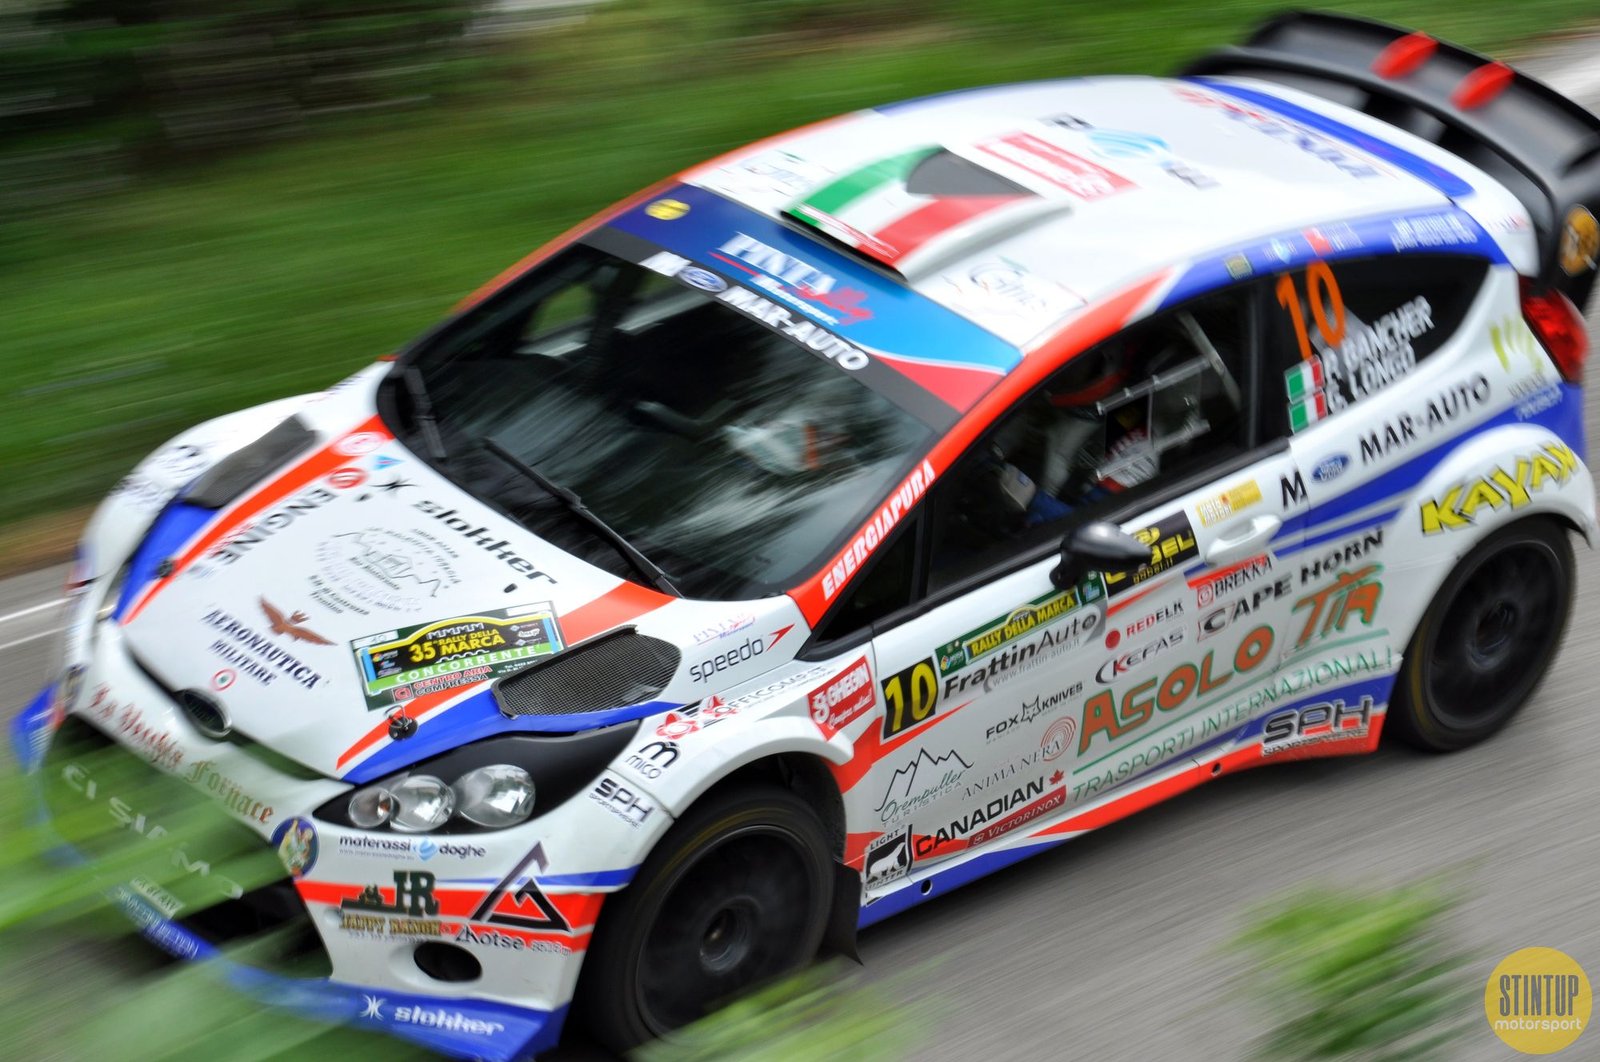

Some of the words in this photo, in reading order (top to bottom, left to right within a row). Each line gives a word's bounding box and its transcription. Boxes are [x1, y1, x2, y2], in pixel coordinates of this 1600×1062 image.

[715, 285, 870, 371] MAR-AUTO
[1276, 260, 1345, 361] 10
[1280, 468, 1308, 510] M
[1358, 375, 1490, 465] MAR-AUTO
[1419, 441, 1577, 536] KAYAK
[211, 488, 338, 566] ENGINE
[412, 500, 558, 585] slokker
[822, 458, 935, 601] ENERGIAPURA
[1203, 571, 1293, 634] CAPE
[1301, 527, 1384, 584] HORN
[1215, 555, 1273, 597] BREKKA
[202, 608, 321, 690] AERONAUTICA
[441, 634, 506, 656] MARCA
[471, 628, 500, 641] DELLA
[970, 630, 1001, 656] RALLY
[1004, 616, 1036, 640] DELLA
[1036, 594, 1076, 621] MARCA
[211, 639, 280, 687] MILITARE
[396, 645, 537, 683] CONCORRENTE
[413, 671, 462, 690] CENTRO
[463, 665, 493, 678] ARIA
[416, 673, 489, 696] COMPRESSA
[689, 638, 764, 683] speedo
[884, 663, 938, 732] 10
[986, 714, 1018, 739] FOX
[1042, 682, 1083, 710] KNIVES
[1077, 623, 1275, 758] ASOLO
[1073, 731, 1194, 801] TRASPORTI
[1200, 646, 1394, 744] INTERNAZIONALI
[1264, 698, 1371, 744] SPH
[625, 755, 661, 779] mico
[595, 778, 655, 822] SPH
[916, 776, 1044, 858] CANADIAN
[989, 794, 1062, 838] VICTORINOX
[340, 835, 411, 851] materassi
[439, 842, 486, 859] doghe
[870, 830, 899, 851] LIGHT
[394, 1004, 504, 1036] slokker
